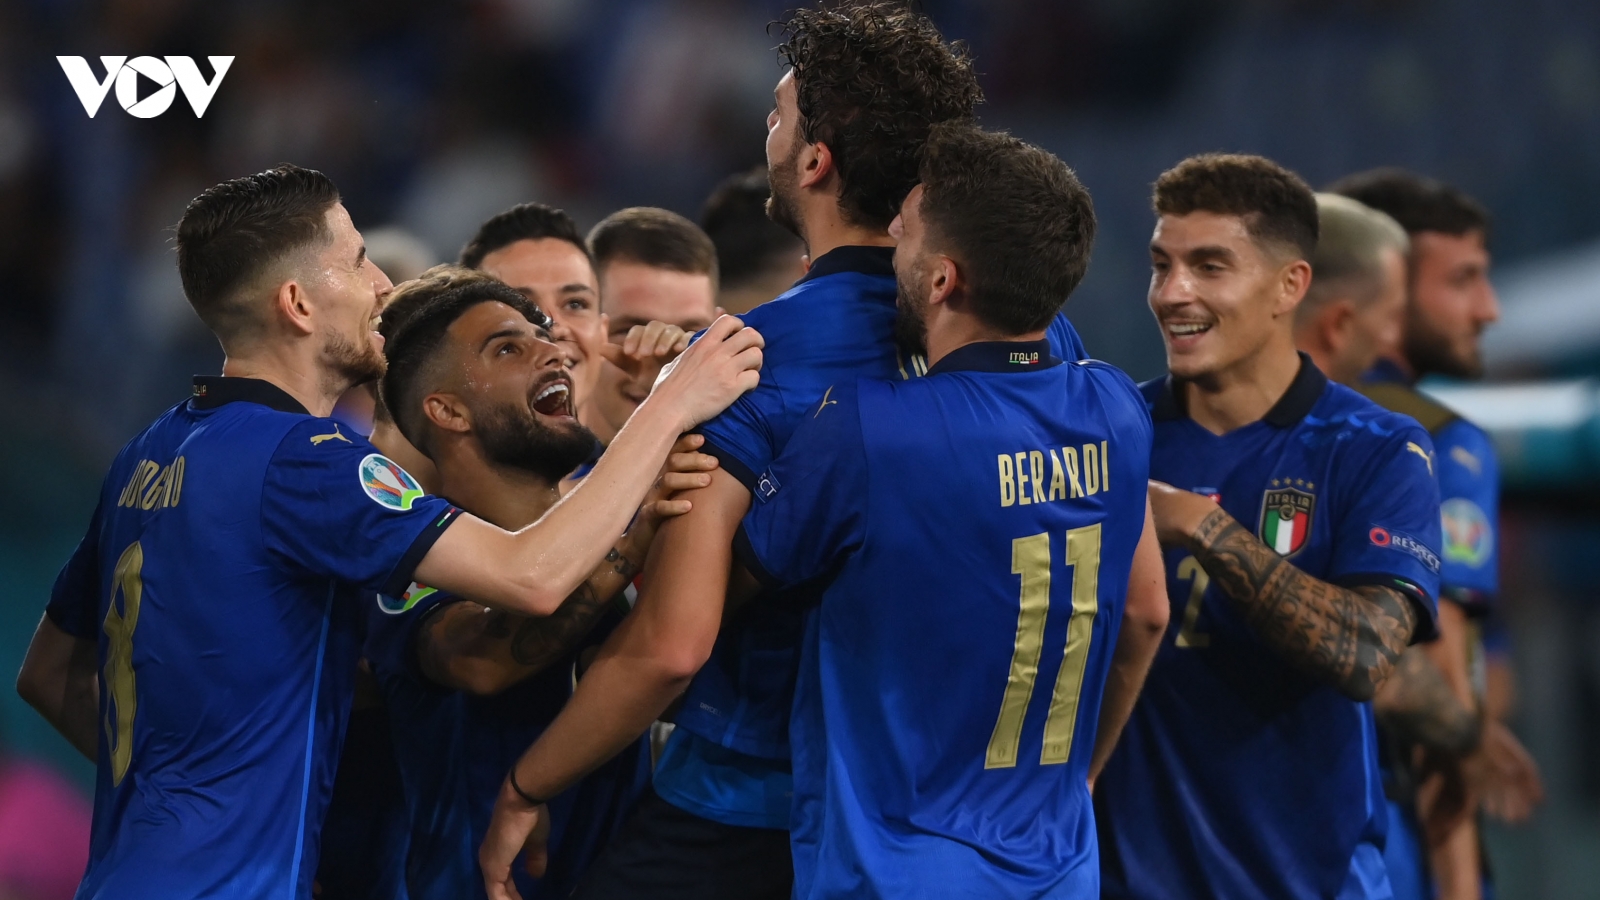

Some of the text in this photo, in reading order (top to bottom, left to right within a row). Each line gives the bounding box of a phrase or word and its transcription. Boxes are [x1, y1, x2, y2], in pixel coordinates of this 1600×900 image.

[1009, 352, 1039, 361] ITALIA
[998, 440, 1109, 507] BERARDI
[1269, 494, 1310, 507] ITALIA
[1392, 535, 1440, 570] RESPECT
[1175, 555, 1210, 647] 2
[103, 541, 143, 787] 8
[984, 522, 1102, 769] 11
